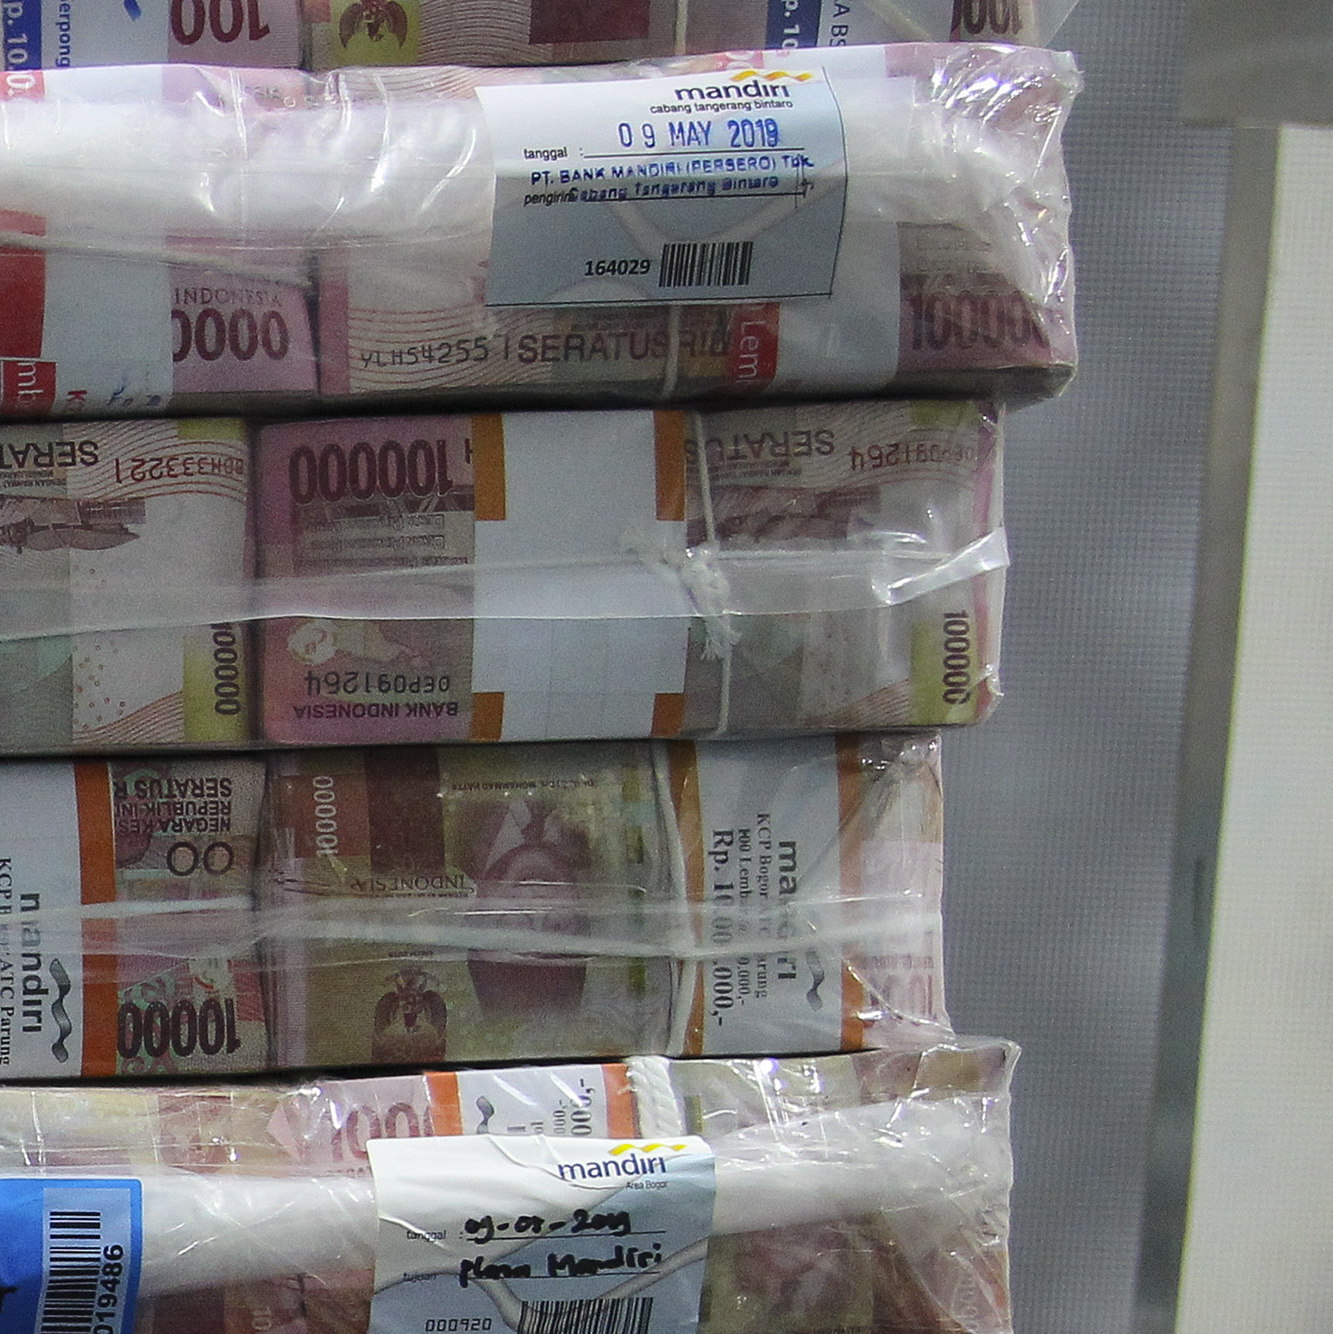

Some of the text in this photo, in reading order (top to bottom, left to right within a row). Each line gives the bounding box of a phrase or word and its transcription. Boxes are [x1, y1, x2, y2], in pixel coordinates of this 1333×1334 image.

[675, 82, 791, 102] mandiri
[650, 99, 794, 115] cabang tangerang bintaro
[668, 117, 781, 148] MAY 2019
[524, 146, 568, 161] tanggal
[530, 171, 555, 186] PT.
[559, 168, 606, 185] BANK
[611, 165, 682, 181] MANDIRI
[583, 259, 651, 277] 164029
[289, 443, 454, 500] 100000
[941, 608, 974, 706] 100000
[292, 701, 459, 720] BANK INDONESIA
[141, 777, 232, 800] SERATUS
[708, 829, 736, 874] Rp.
[754, 812, 773, 898] KCP Bogor
[557, 1153, 667, 1182] mandiri
[625, 1180, 668, 1191] Area Bogor
[406, 1229, 447, 1243] tanggal
[547, 1242, 663, 1277] Mandiri
[403, 1271, 437, 1284] tujuan
[425, 1318, 492, 1333] 000920
